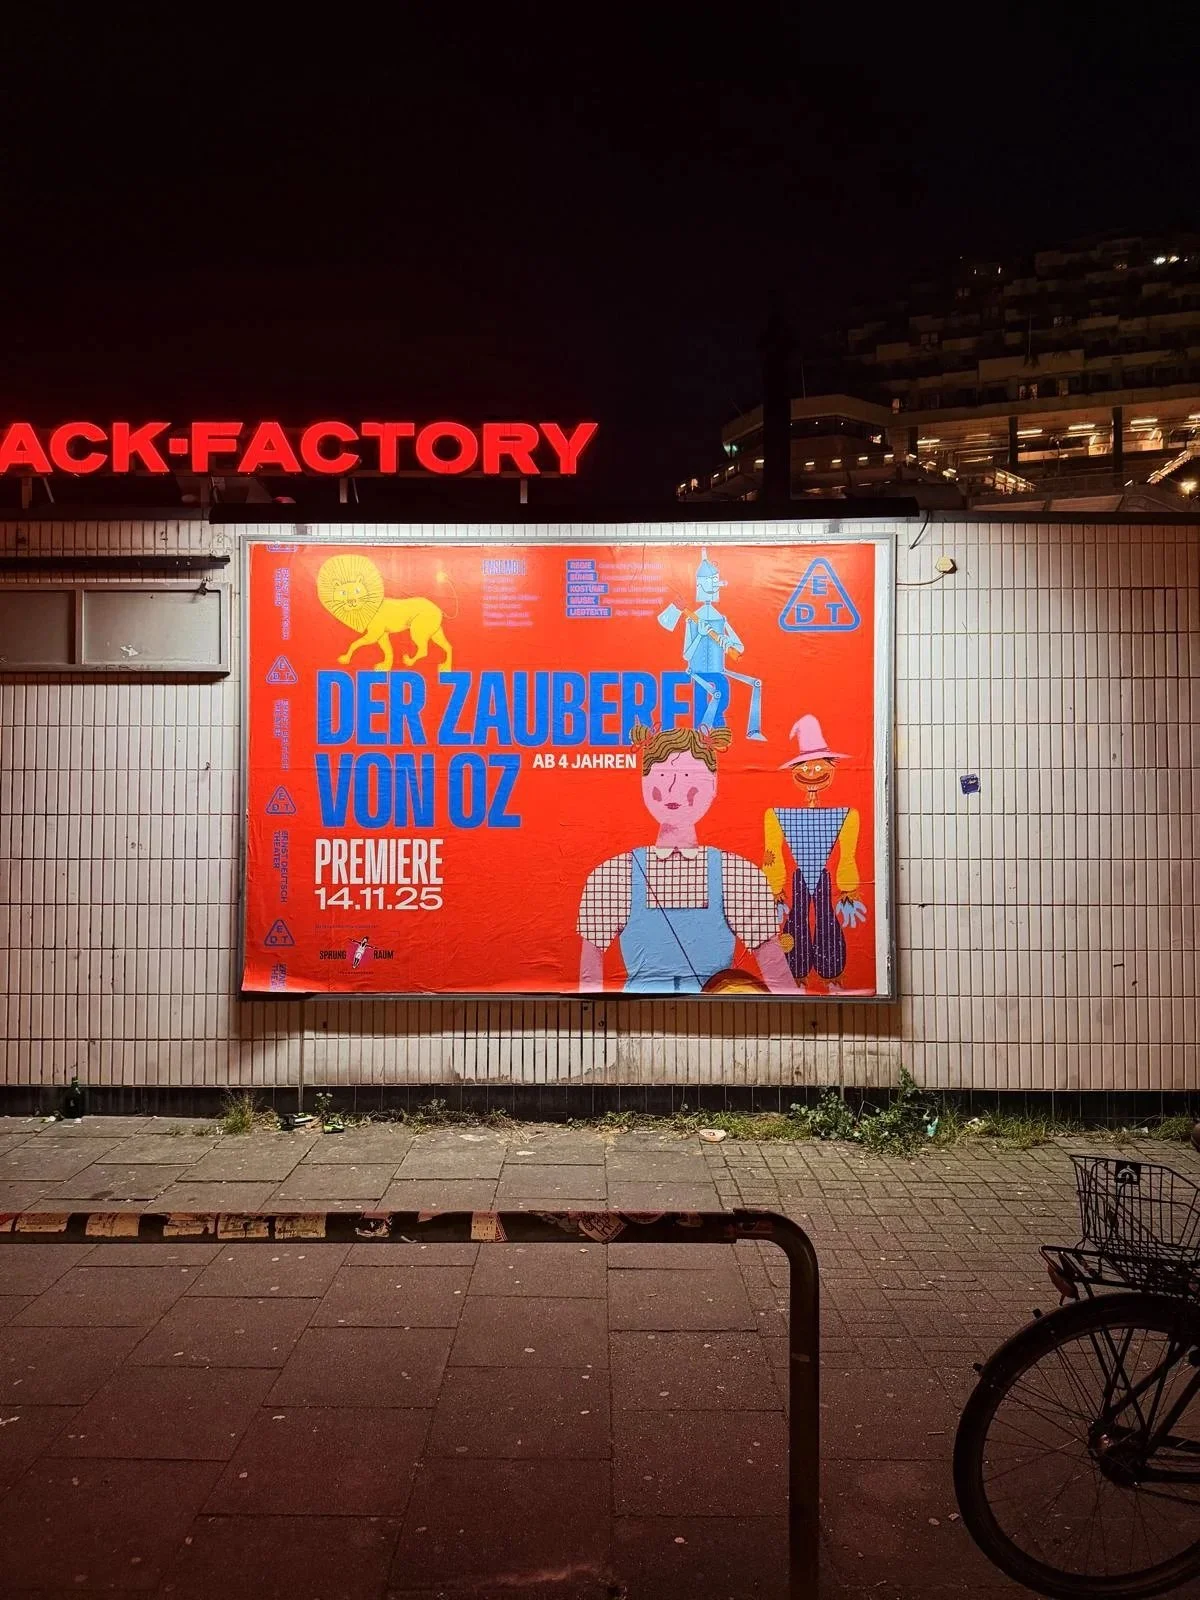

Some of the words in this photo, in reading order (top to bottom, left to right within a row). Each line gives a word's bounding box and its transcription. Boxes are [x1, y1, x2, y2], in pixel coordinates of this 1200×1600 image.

[316, 670, 427, 746] DER
[533, 753, 554, 768] AB
[557, 753, 568, 768] 4
[571, 753, 637, 769] JAHREN
[314, 751, 435, 829] VON
[448, 751, 522, 829] OZ
[273, 831, 281, 869] THEATER
[281, 830, 289, 860] ERNST
[315, 838, 444, 885] PREMIERE
[280, 861, 288, 903] DEUTSCH
[314, 886, 443, 910] 14.11.25
[319, 950, 347, 960] SPRUNG
[373, 950, 394, 960] RAUM
